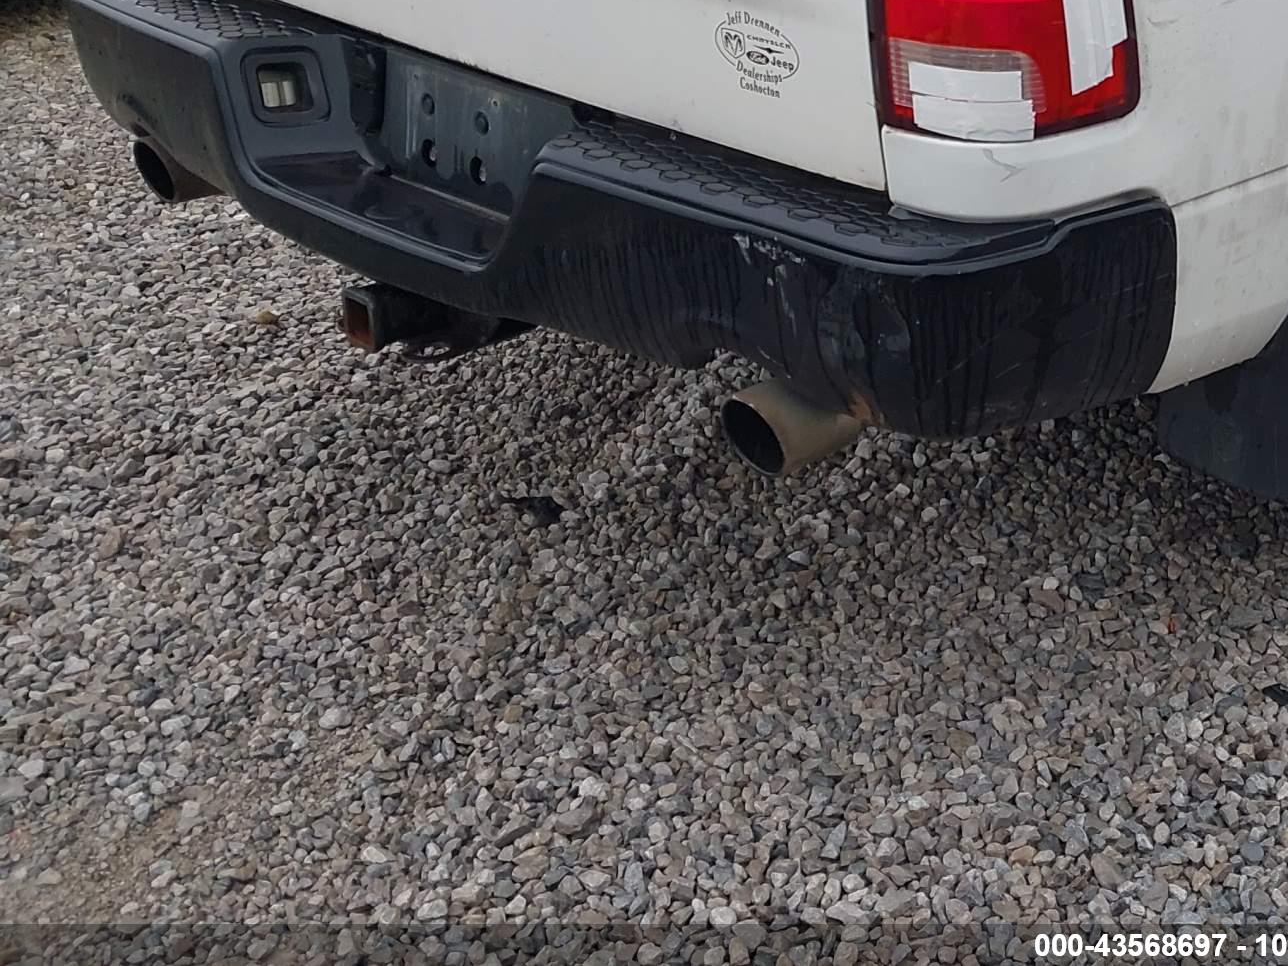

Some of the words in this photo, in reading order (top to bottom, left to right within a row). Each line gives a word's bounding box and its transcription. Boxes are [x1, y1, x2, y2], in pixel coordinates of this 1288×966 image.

[726, 10, 742, 26] Jeff
[743, 11, 781, 38] Drennen
[736, 59, 783, 86] Dealerships
[770, 56, 795, 73] Jeep
[739, 76, 781, 99] Coshocton
